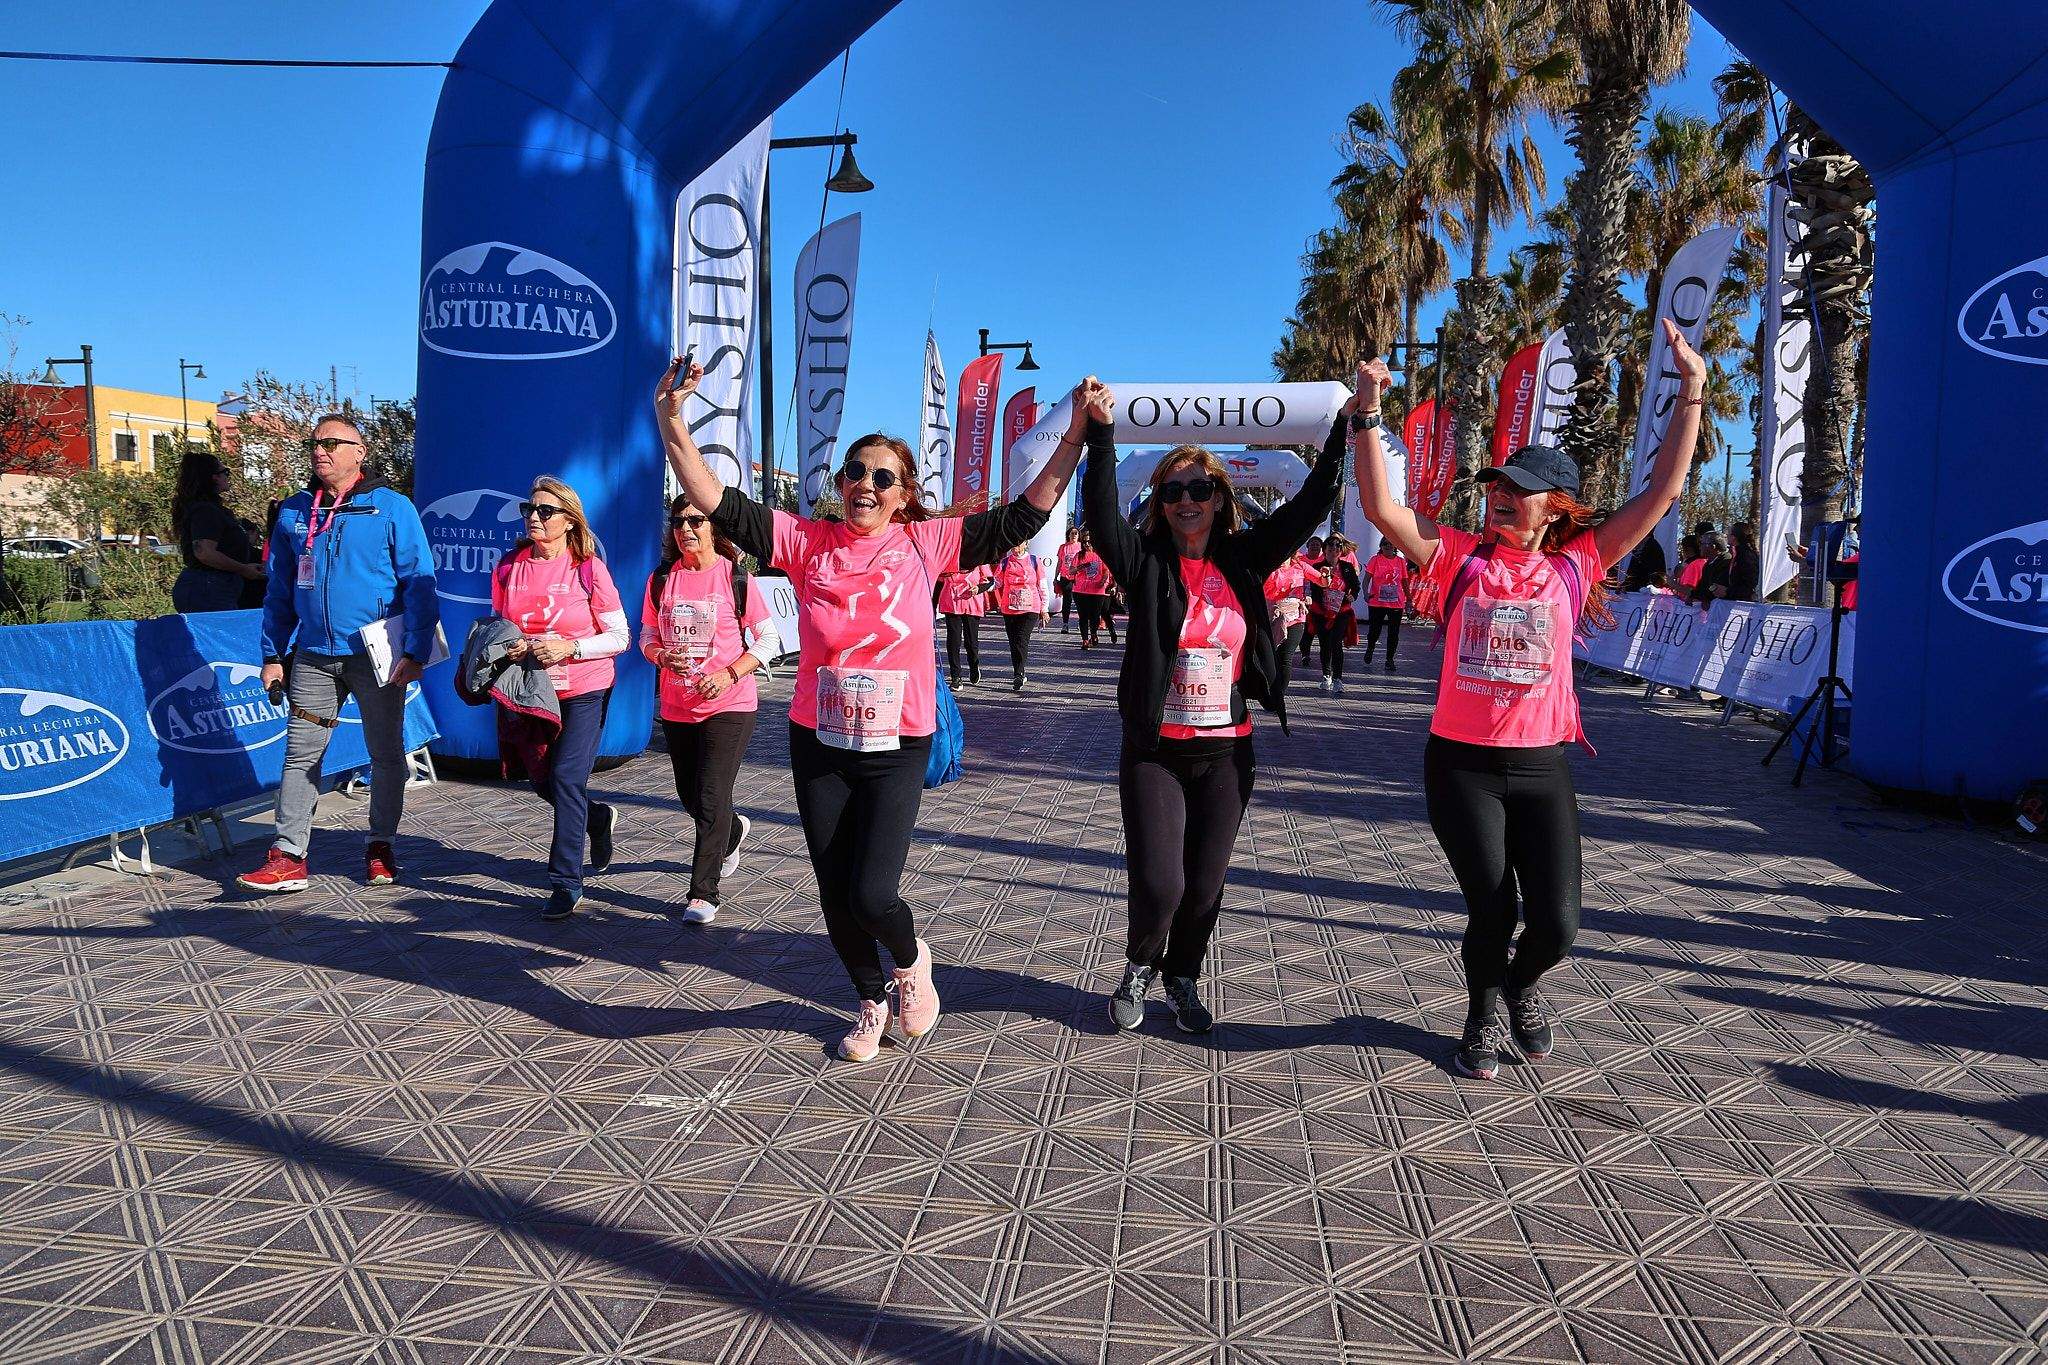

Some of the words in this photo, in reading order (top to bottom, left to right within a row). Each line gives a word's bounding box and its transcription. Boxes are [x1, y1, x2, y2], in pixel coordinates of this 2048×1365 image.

[440, 282, 504, 294] CENTRAL
[513, 284, 593, 304] LECHERA
[422, 287, 600, 340] ASTURIANA
[1127, 395, 1286, 428] OYSHO
[1503, 369, 1535, 466] antander
[968, 379, 990, 467] Santander
[1035, 431, 1063, 442] OYS
[1411, 422, 1426, 492] Santander
[432, 526, 496, 540] CENTRAL
[673, 625, 697, 636] 016
[1626, 606, 1693, 647] OYSHO
[1490, 636, 1528, 651] 016
[1722, 615, 1818, 665] OYSHO
[240, 686, 267, 700] LECH
[1177, 683, 1208, 696] 016
[1456, 680, 1492, 696] CARRERA
[33, 714, 101, 733] LECHERA
[167, 695, 291, 740] ASTURIANA
[843, 705, 876, 720] 016
[0, 728, 119, 771] URIANA
